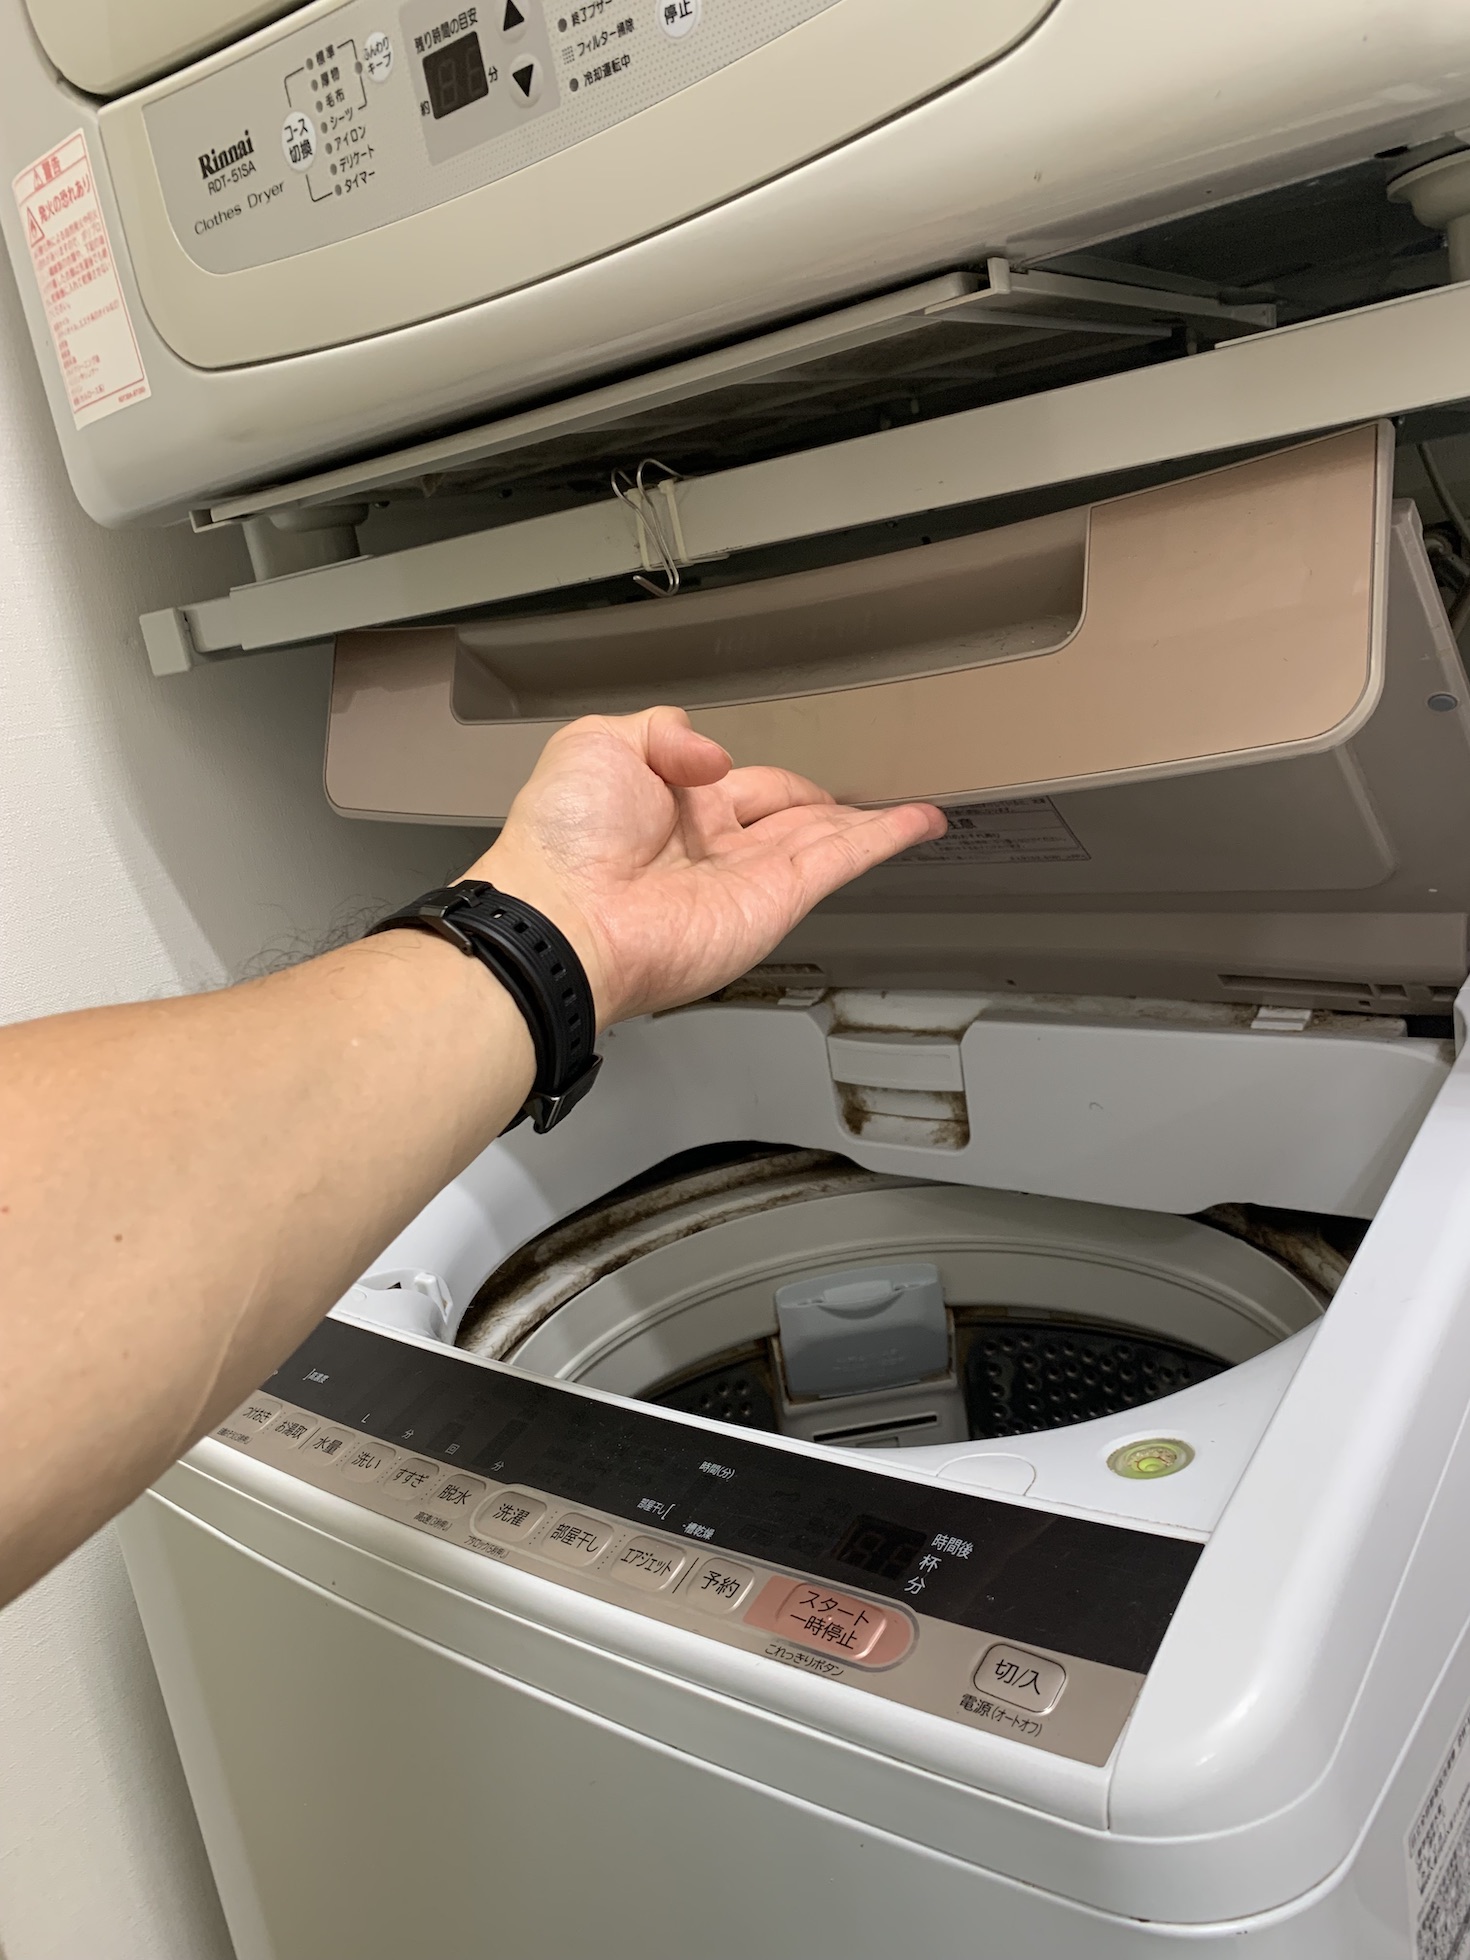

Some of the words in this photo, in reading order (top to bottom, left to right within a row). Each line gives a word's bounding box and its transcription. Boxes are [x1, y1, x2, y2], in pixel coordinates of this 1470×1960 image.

[664, 0, 693, 25] 停止
[414, 7, 478, 54] 残り時間の目安
[576, 18, 635, 57] フィルター掃除
[363, 36, 390, 61] ふんわり
[367, 52, 392, 75] キープ
[488, 66, 499, 83] 分
[583, 53, 631, 87] 冷却運転中
[325, 88, 345, 108] 毛布
[419, 100, 430, 117] 約
[284, 118, 308, 142] コース
[330, 107, 353, 130] シーツ
[334, 125, 367, 151] アイロン
[198, 130, 255, 180] Rinnai
[289, 140, 313, 164] 切換
[339, 144, 375, 173] デリケート
[207, 160, 257, 196] RDT-51SA
[344, 170, 376, 194] タイマー
[193, 203, 242, 235] Clothes
[247, 180, 285, 209] Dryer
[274, 1420, 308, 1440] お湯取
[402, 1429, 414, 1440] 分
[312, 1435, 343, 1456] 水量
[444, 1443, 461, 1455] 回
[351, 1451, 381, 1470] 洗い
[491, 1460, 505, 1472] 分
[698, 1460, 736, 1481] 時間(分)
[392, 1467, 429, 1488] すすぎ
[437, 1484, 472, 1506] 脱水
[492, 1502, 531, 1528] 洗濯
[550, 1523, 600, 1554] 部屋干し
[931, 1533, 975, 1560] 時間後
[620, 1547, 675, 1577] エアジェット
[919, 1554, 942, 1573] 杯
[700, 1571, 741, 1599] 予約
[904, 1576, 928, 1595] 分
[799, 1589, 870, 1627] スタート
[790, 1612, 859, 1651] 一時停止
[765, 1643, 845, 1677] これっきりボタン
[995, 1658, 1042, 1696] 切/入
